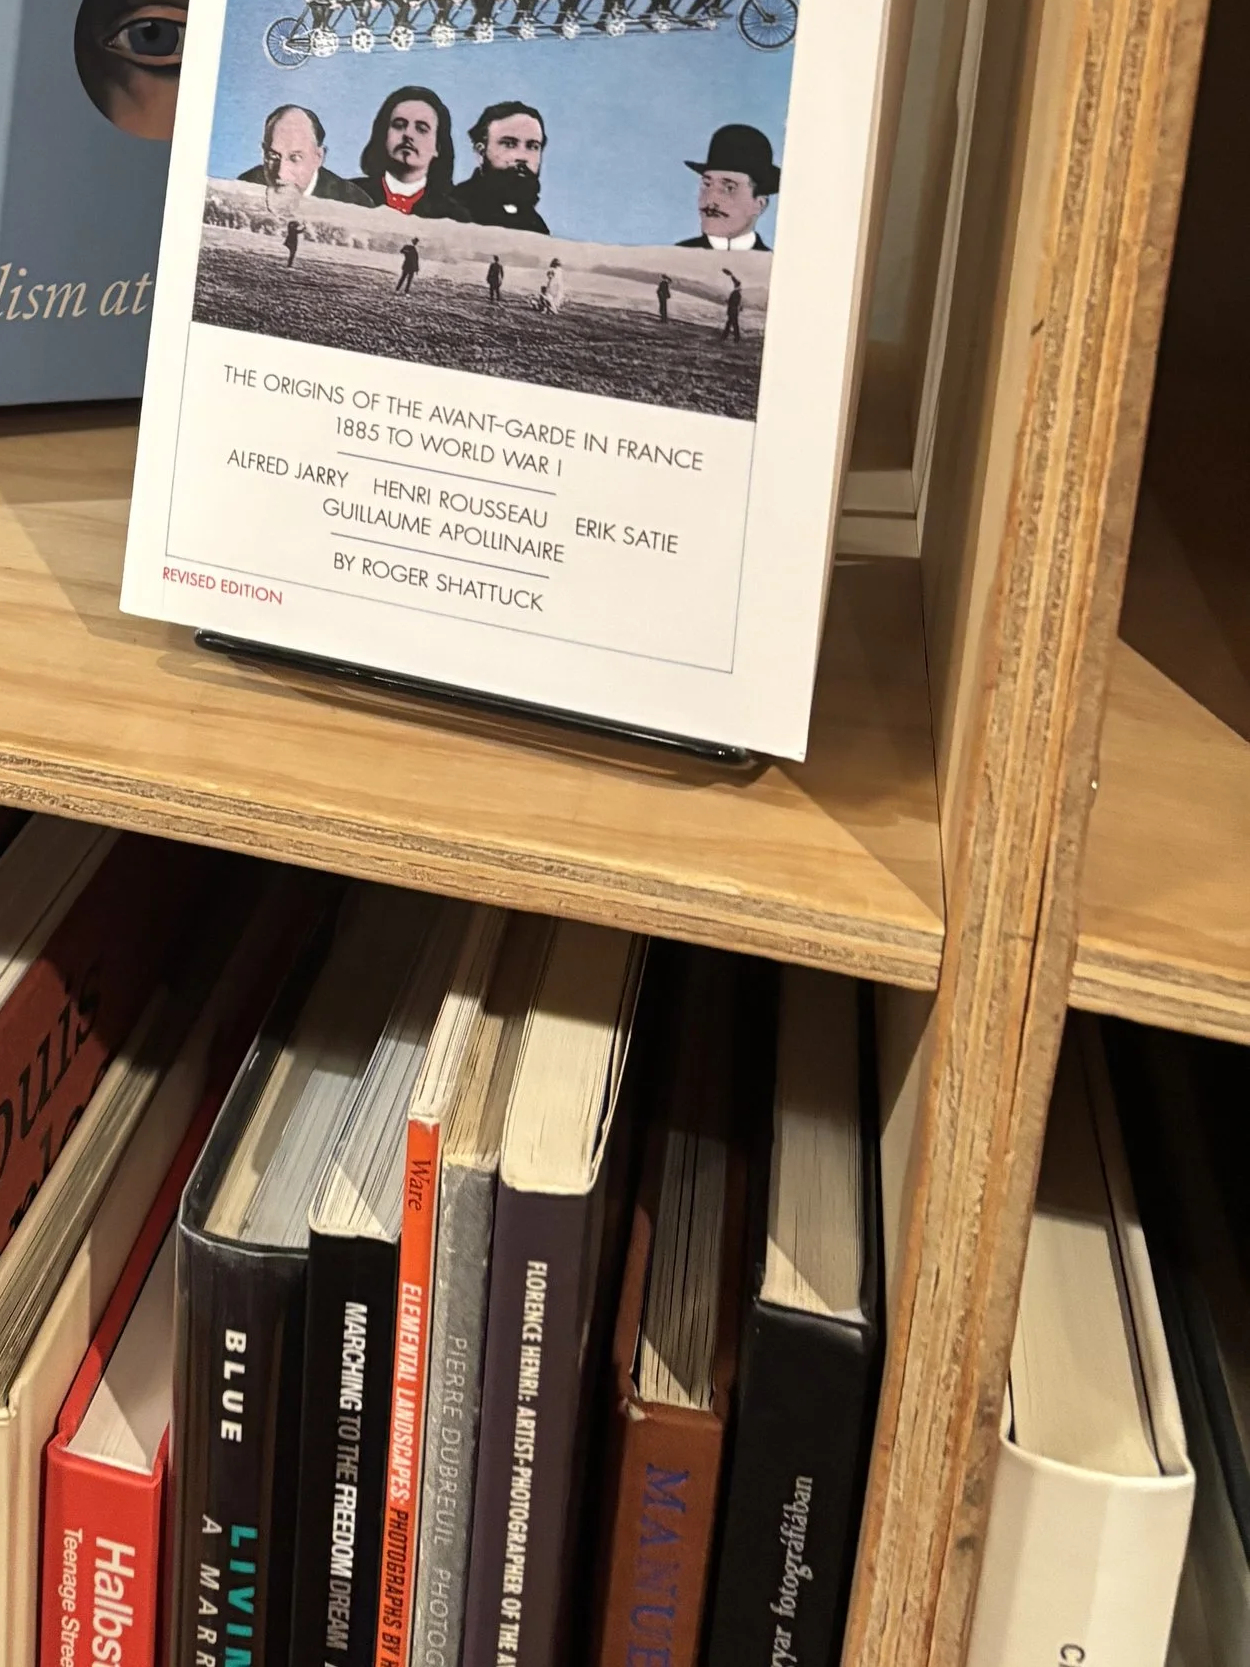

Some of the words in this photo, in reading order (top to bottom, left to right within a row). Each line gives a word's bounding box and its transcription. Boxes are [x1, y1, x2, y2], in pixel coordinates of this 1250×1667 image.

[100, 272, 154, 317] at
[224, 365, 258, 388] THE
[263, 374, 345, 405] ORIGINS
[352, 390, 381, 411] OF
[386, 395, 423, 420] THE
[429, 405, 576, 448] AVANT-GARDE
[584, 432, 608, 455] IN
[617, 438, 704, 472] FRANCE
[336, 417, 380, 442] 1885
[386, 426, 414, 449] TO
[420, 433, 496, 464] WORLD
[502, 448, 549, 475] WAR
[556, 459, 563, 477] I
[227, 449, 290, 477] ALFRED
[294, 462, 349, 489] JARRY
[373, 477, 432, 506] HENRI
[439, 490, 549, 529] ROUSSEAU
[575, 517, 617, 542] ERIK
[622, 526, 679, 554] SATIE
[322, 498, 433, 537] GUILLAUME
[438, 522, 566, 564] APOLLINAIRE
[162, 566, 216, 590] REVISED
[221, 579, 283, 605] EDITION
[333, 552, 356, 572] BY
[362, 557, 429, 588] ROGER
[436, 573, 544, 612] SHATTUCK
[408, 1159, 432, 1211] Ware
[396, 1282, 423, 1379] ELEMENTAL
[522, 1259, 548, 1343] FLORENCE
[220, 1329, 247, 1443] BLUE
[338, 1301, 368, 1411] MARCHING
[441, 1334, 467, 1417] PIERRE
[517, 1343, 542, 1402] HENRI:
[334, 1440, 361, 1482] THE
[338, 1414, 363, 1439] TO
[389, 1378, 415, 1504] LANDSCAPES:
[202, 1514, 223, 1534] A
[434, 1427, 462, 1547] DUBREUIL
[503, 1404, 537, 1595] ARTIST-PHOTOGRAPHER
[329, 1482, 358, 1579] FREEDOM
[381, 1505, 409, 1619] PHOTOGRAPHS
[769, 1475, 814, 1619] fotográfiában
[58, 1528, 83, 1612] Teenage
[501, 1596, 521, 1621] OF
[325, 1580, 349, 1651] DREAM
[380, 1620, 402, 1645] BY
[498, 1621, 520, 1648] THE
